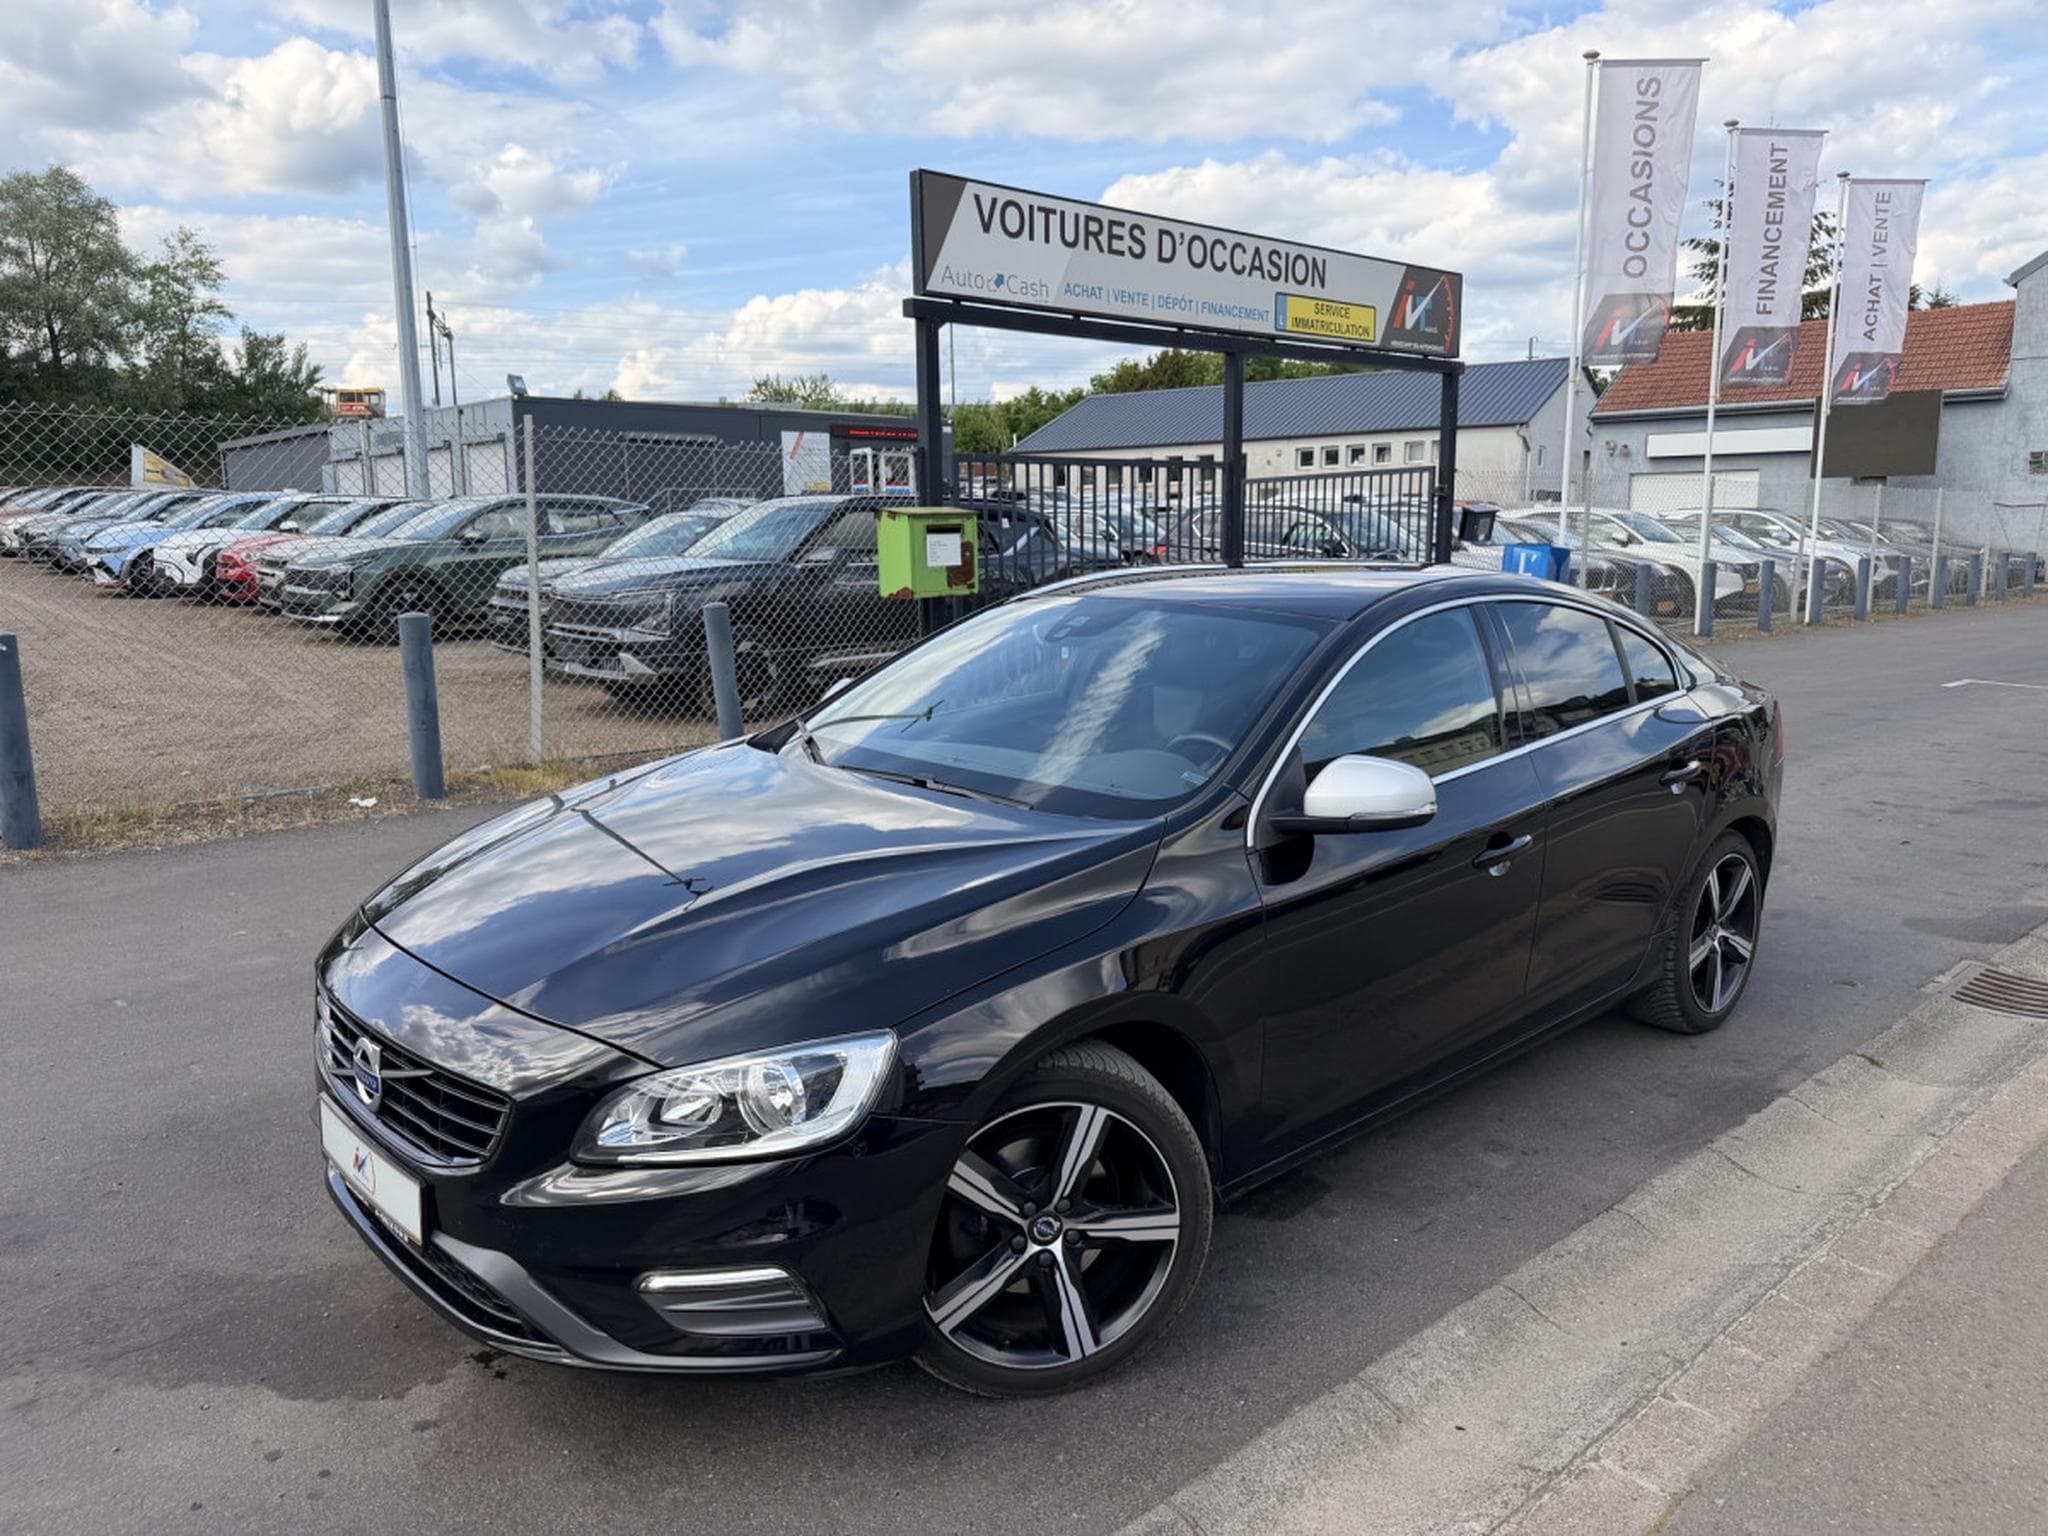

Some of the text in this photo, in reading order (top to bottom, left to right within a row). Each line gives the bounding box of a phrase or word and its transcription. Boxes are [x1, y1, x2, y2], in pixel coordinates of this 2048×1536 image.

[1623, 76, 1662, 279] OCCASIONS
[974, 193, 1146, 260] VOITURES
[1757, 142, 1789, 316] FINANCEMENT
[1006, 274, 1049, 298] Cash
[1863, 274, 1883, 342] ACHAT
[1873, 191, 1892, 262] VENTE
[1064, 282, 1103, 300] ACHAT
[1113, 288, 1149, 306] VENTE
[1201, 301, 1270, 322] FINANCEMENT
[1291, 316, 1370, 338] IMMATRICULATION
[1313, 302, 1351, 319] SERVICE
